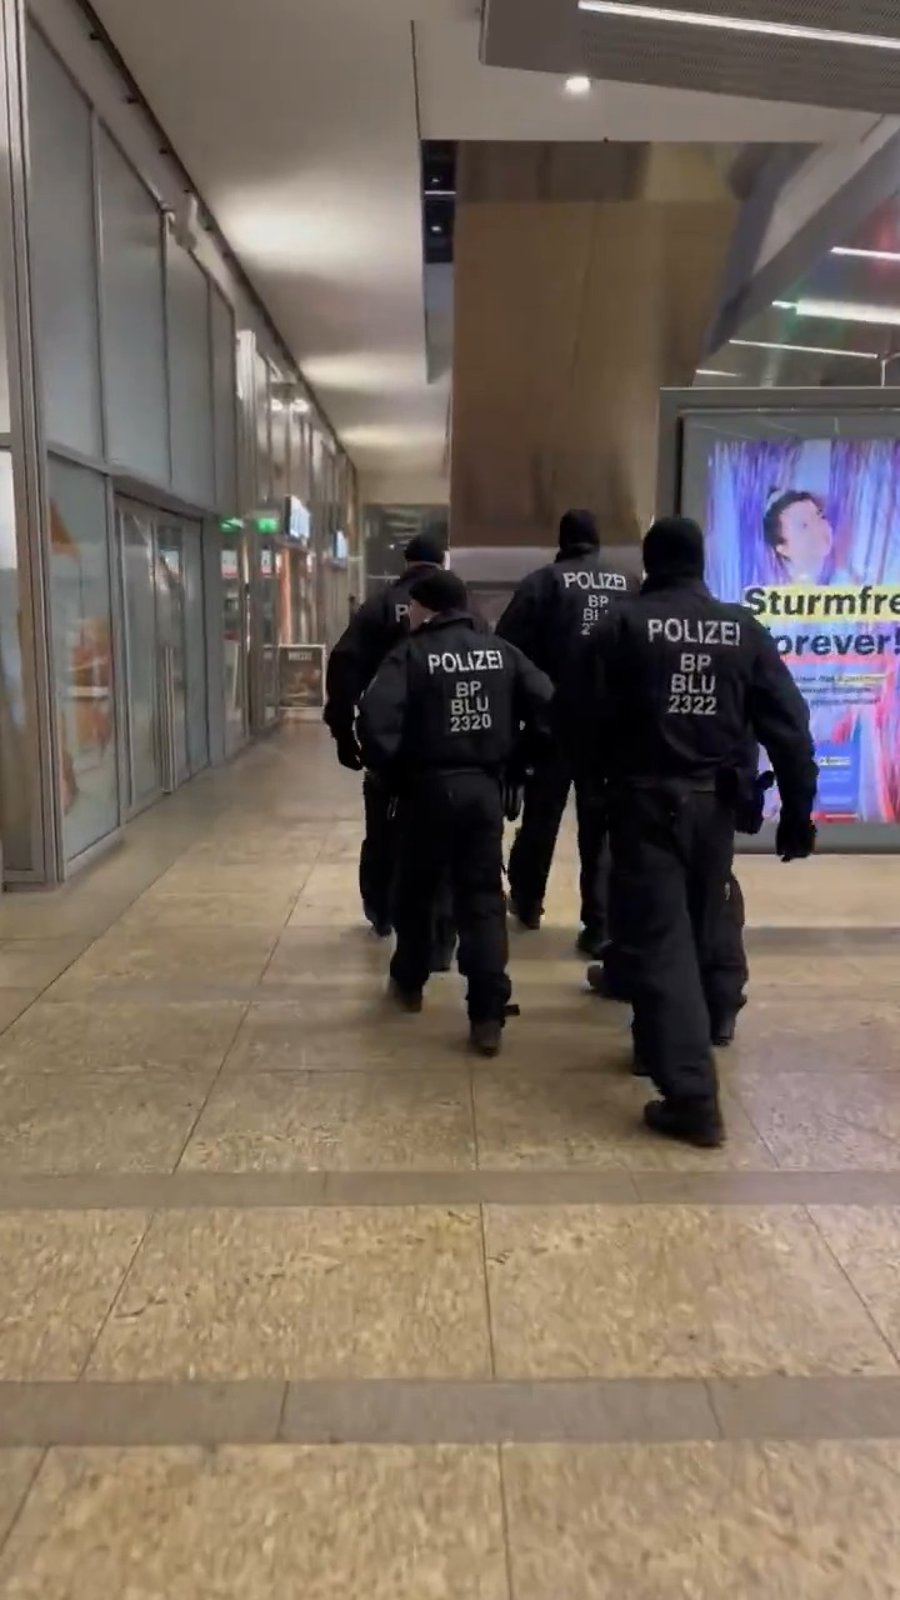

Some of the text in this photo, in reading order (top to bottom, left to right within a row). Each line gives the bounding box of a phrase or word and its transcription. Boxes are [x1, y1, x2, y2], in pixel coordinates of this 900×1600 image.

[562, 571, 627, 591] POLIZEI
[588, 594, 609, 608] BP
[647, 618, 741, 646] POLIZEI
[768, 626, 900, 656] orever!
[428, 650, 504, 675] POLIZEI
[680, 653, 712, 672] BP
[456, 680, 482, 698] BP
[670, 673, 716, 694] BLU
[451, 696, 489, 715] BLU
[667, 694, 717, 715] 2322
[450, 713, 492, 732] 2320
